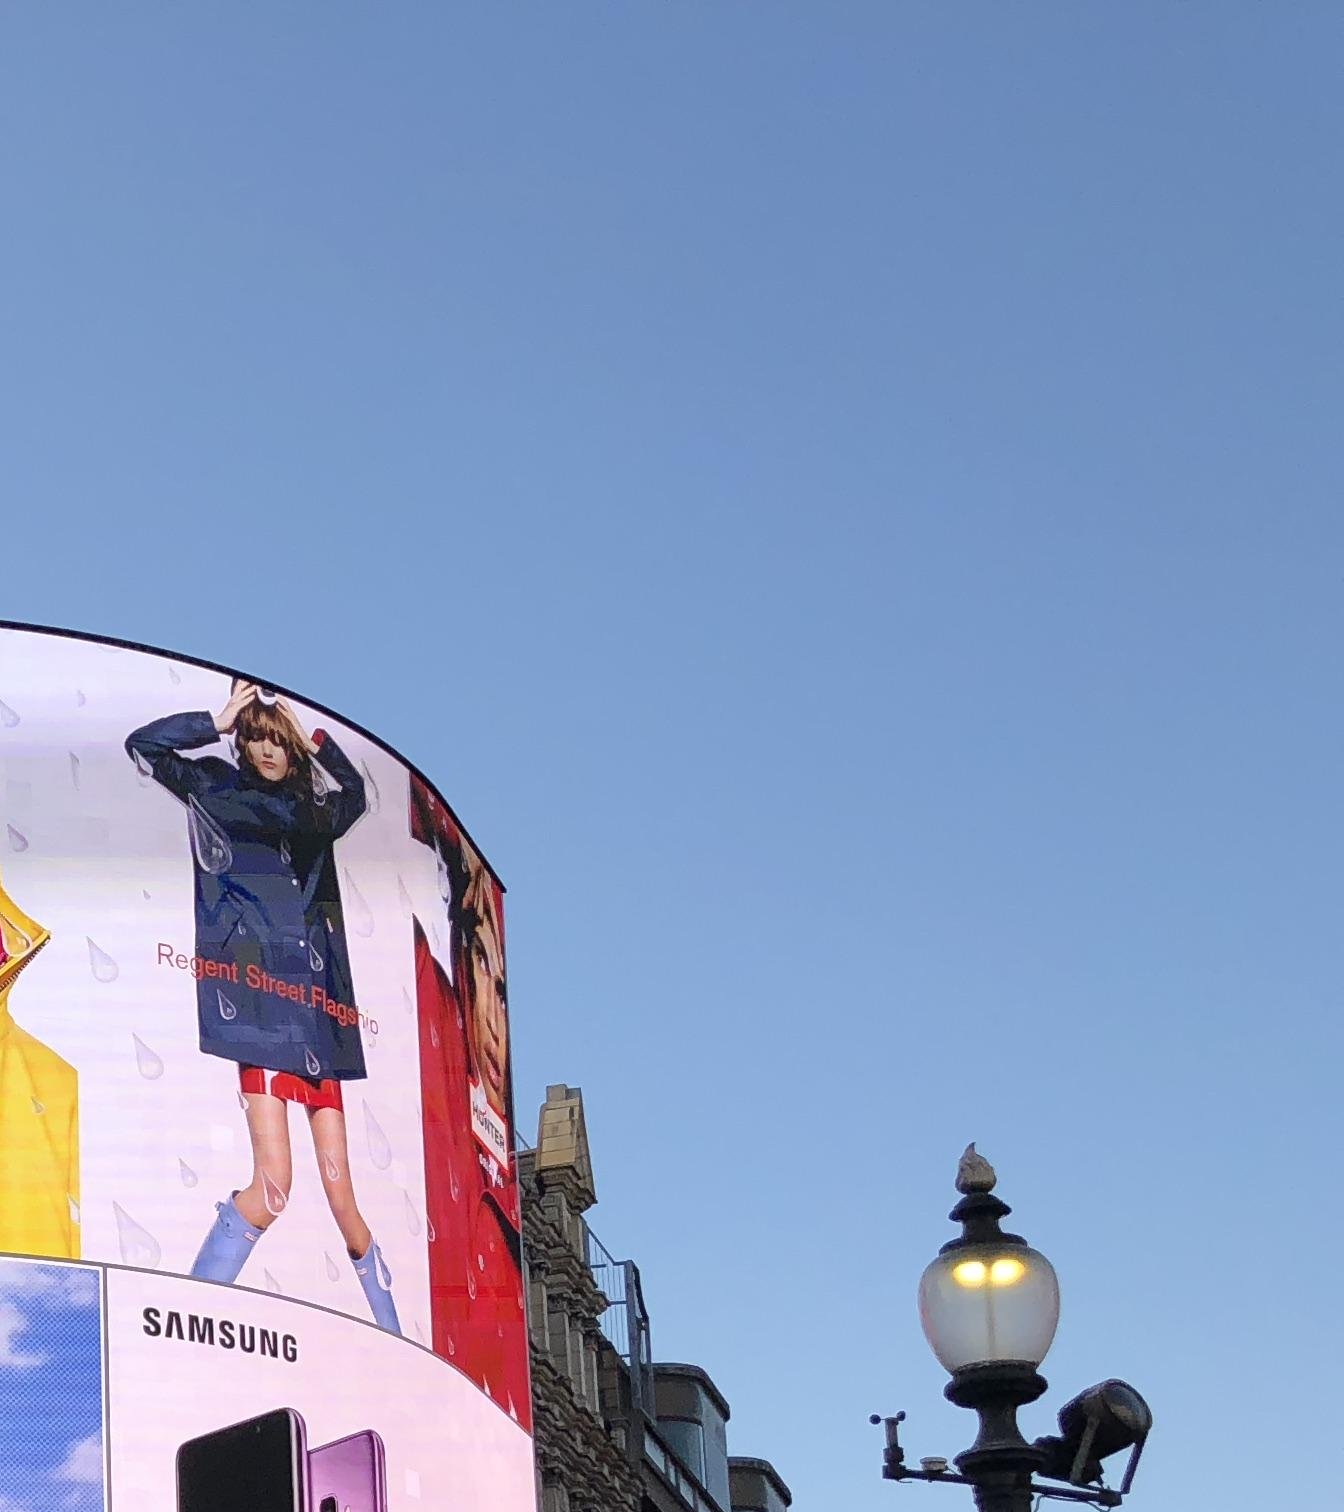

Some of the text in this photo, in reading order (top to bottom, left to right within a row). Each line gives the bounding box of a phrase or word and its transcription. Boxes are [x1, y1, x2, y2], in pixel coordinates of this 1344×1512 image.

[156, 941, 379, 1035] Regent Street Flagship
[142, 1306, 298, 1363] SAMSUNG
